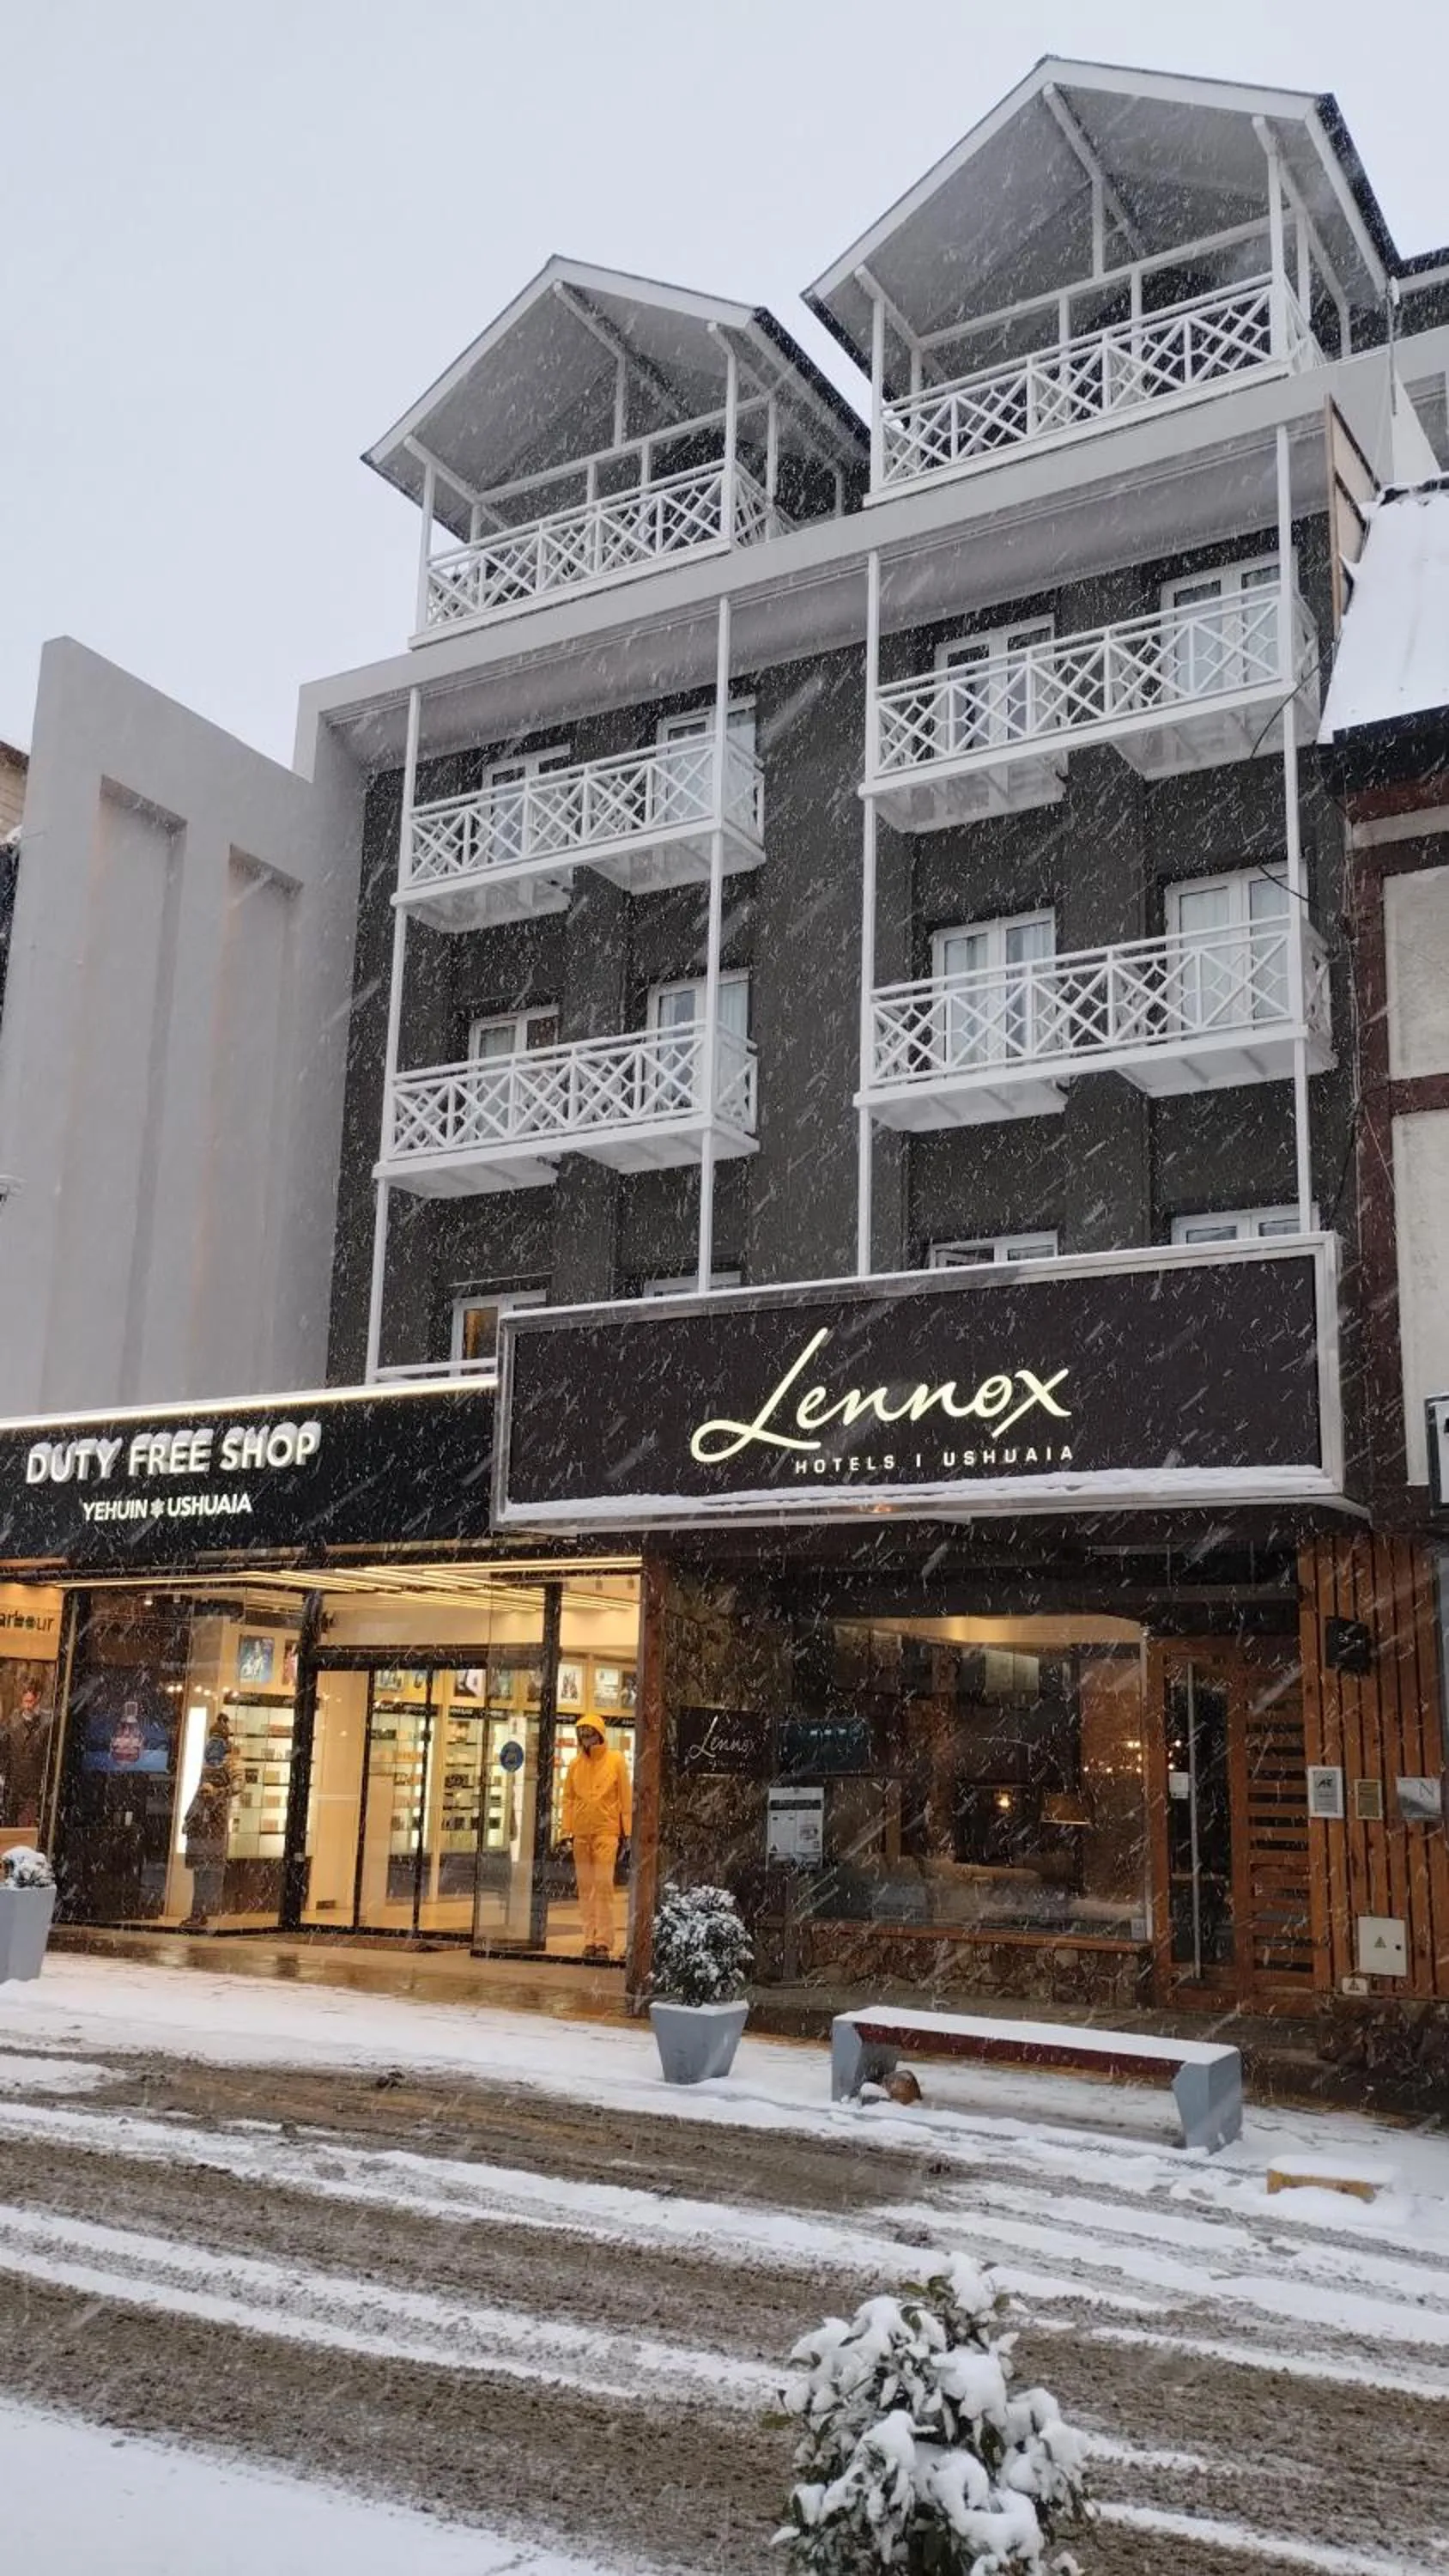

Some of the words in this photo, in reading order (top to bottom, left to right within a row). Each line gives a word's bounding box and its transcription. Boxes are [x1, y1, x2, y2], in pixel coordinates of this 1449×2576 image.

[690, 1327, 1071, 1462] Lennox
[25, 1438, 124, 1484] DUTY
[128, 1429, 214, 1477] FREE
[220, 1421, 322, 1471] SHOP
[795, 1456, 895, 1475] HOTELS
[943, 1445, 1073, 1467] USHUAIA
[83, 1499, 148, 1521] YEHUIN
[167, 1493, 253, 1517] USHUAIA
[688, 1715, 755, 1759] Lennox
